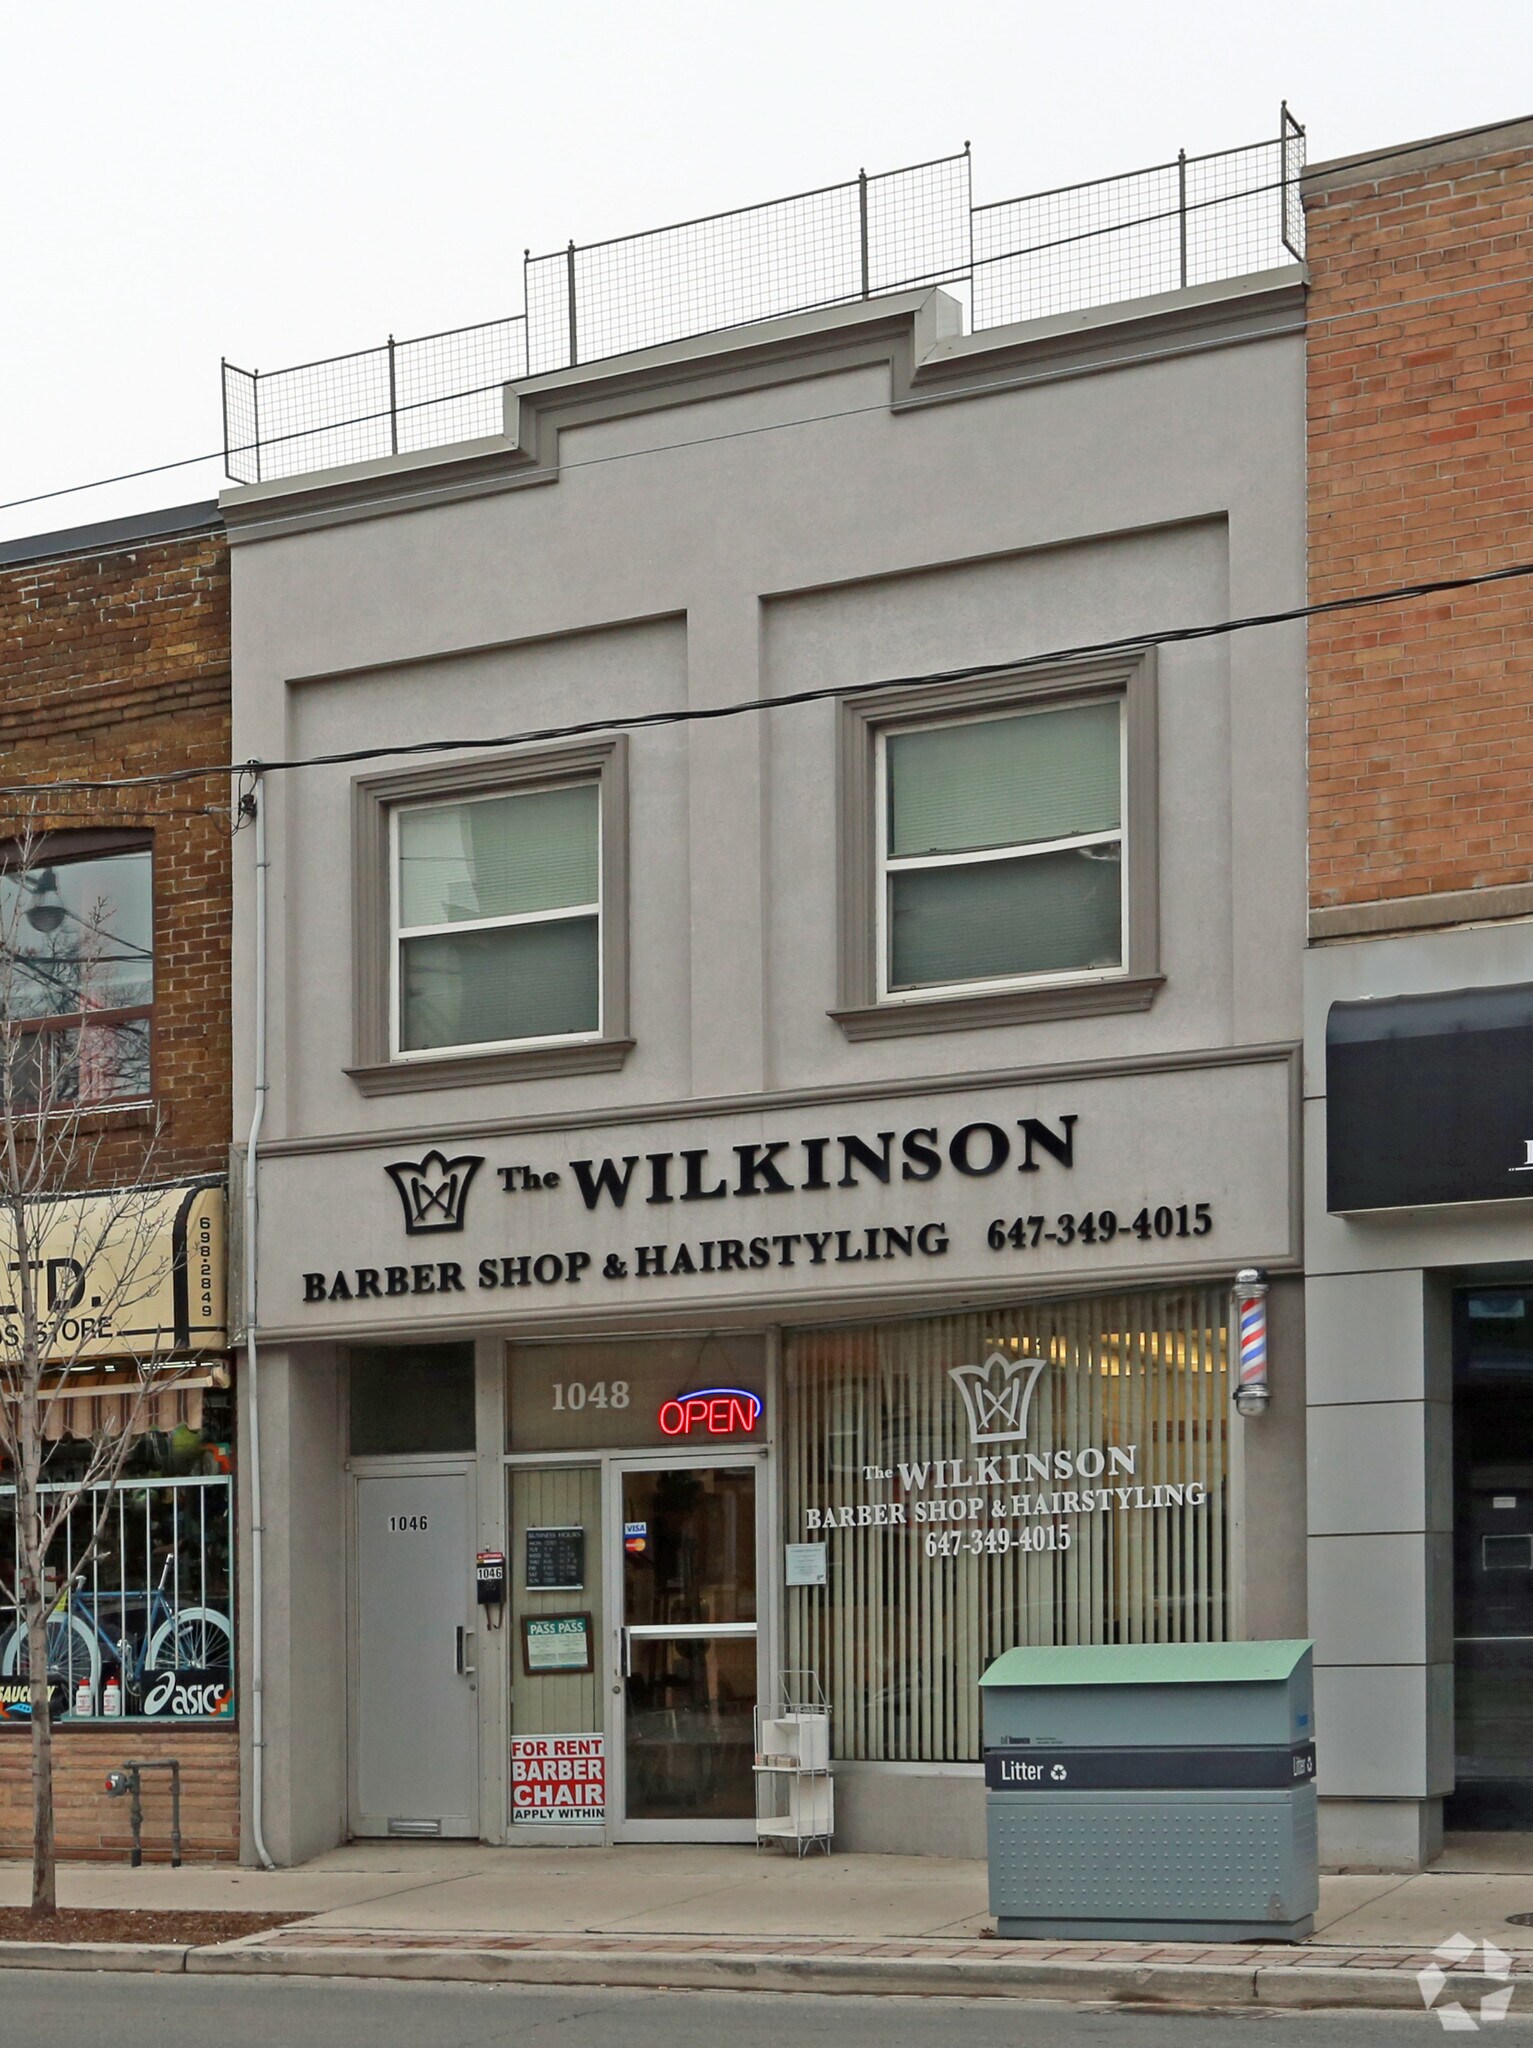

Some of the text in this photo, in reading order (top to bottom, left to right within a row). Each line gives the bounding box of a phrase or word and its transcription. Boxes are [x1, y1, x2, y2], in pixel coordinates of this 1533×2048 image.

[497, 1114, 1078, 1210] The WILKINSON
[302, 1202, 1213, 1302] BARBER SHOP & HAIRSTYLING 647-349-4015
[551, 1381, 630, 1411] 1048
[659, 1398, 756, 1435] OPEN
[863, 1445, 1137, 1491] The WILKINSON
[806, 1482, 1207, 1530] BARBER SHOP & HAIRSTYLING
[390, 1516, 428, 1531] 1046
[627, 1524, 645, 1533] VISA
[924, 1523, 1071, 1557] 647-349-4015
[478, 1568, 502, 1579] 1046
[530, 1622, 584, 1635] PASS PASS
[0, 1685, 56, 1703] SAUCY
[512, 1740, 602, 1757] FOR RENT
[512, 1759, 603, 1781] BARBER
[1001, 1760, 1044, 1780] Litter
[513, 1784, 604, 1806] CHAIR
[515, 1808, 605, 1819] APPLY WITHIN
